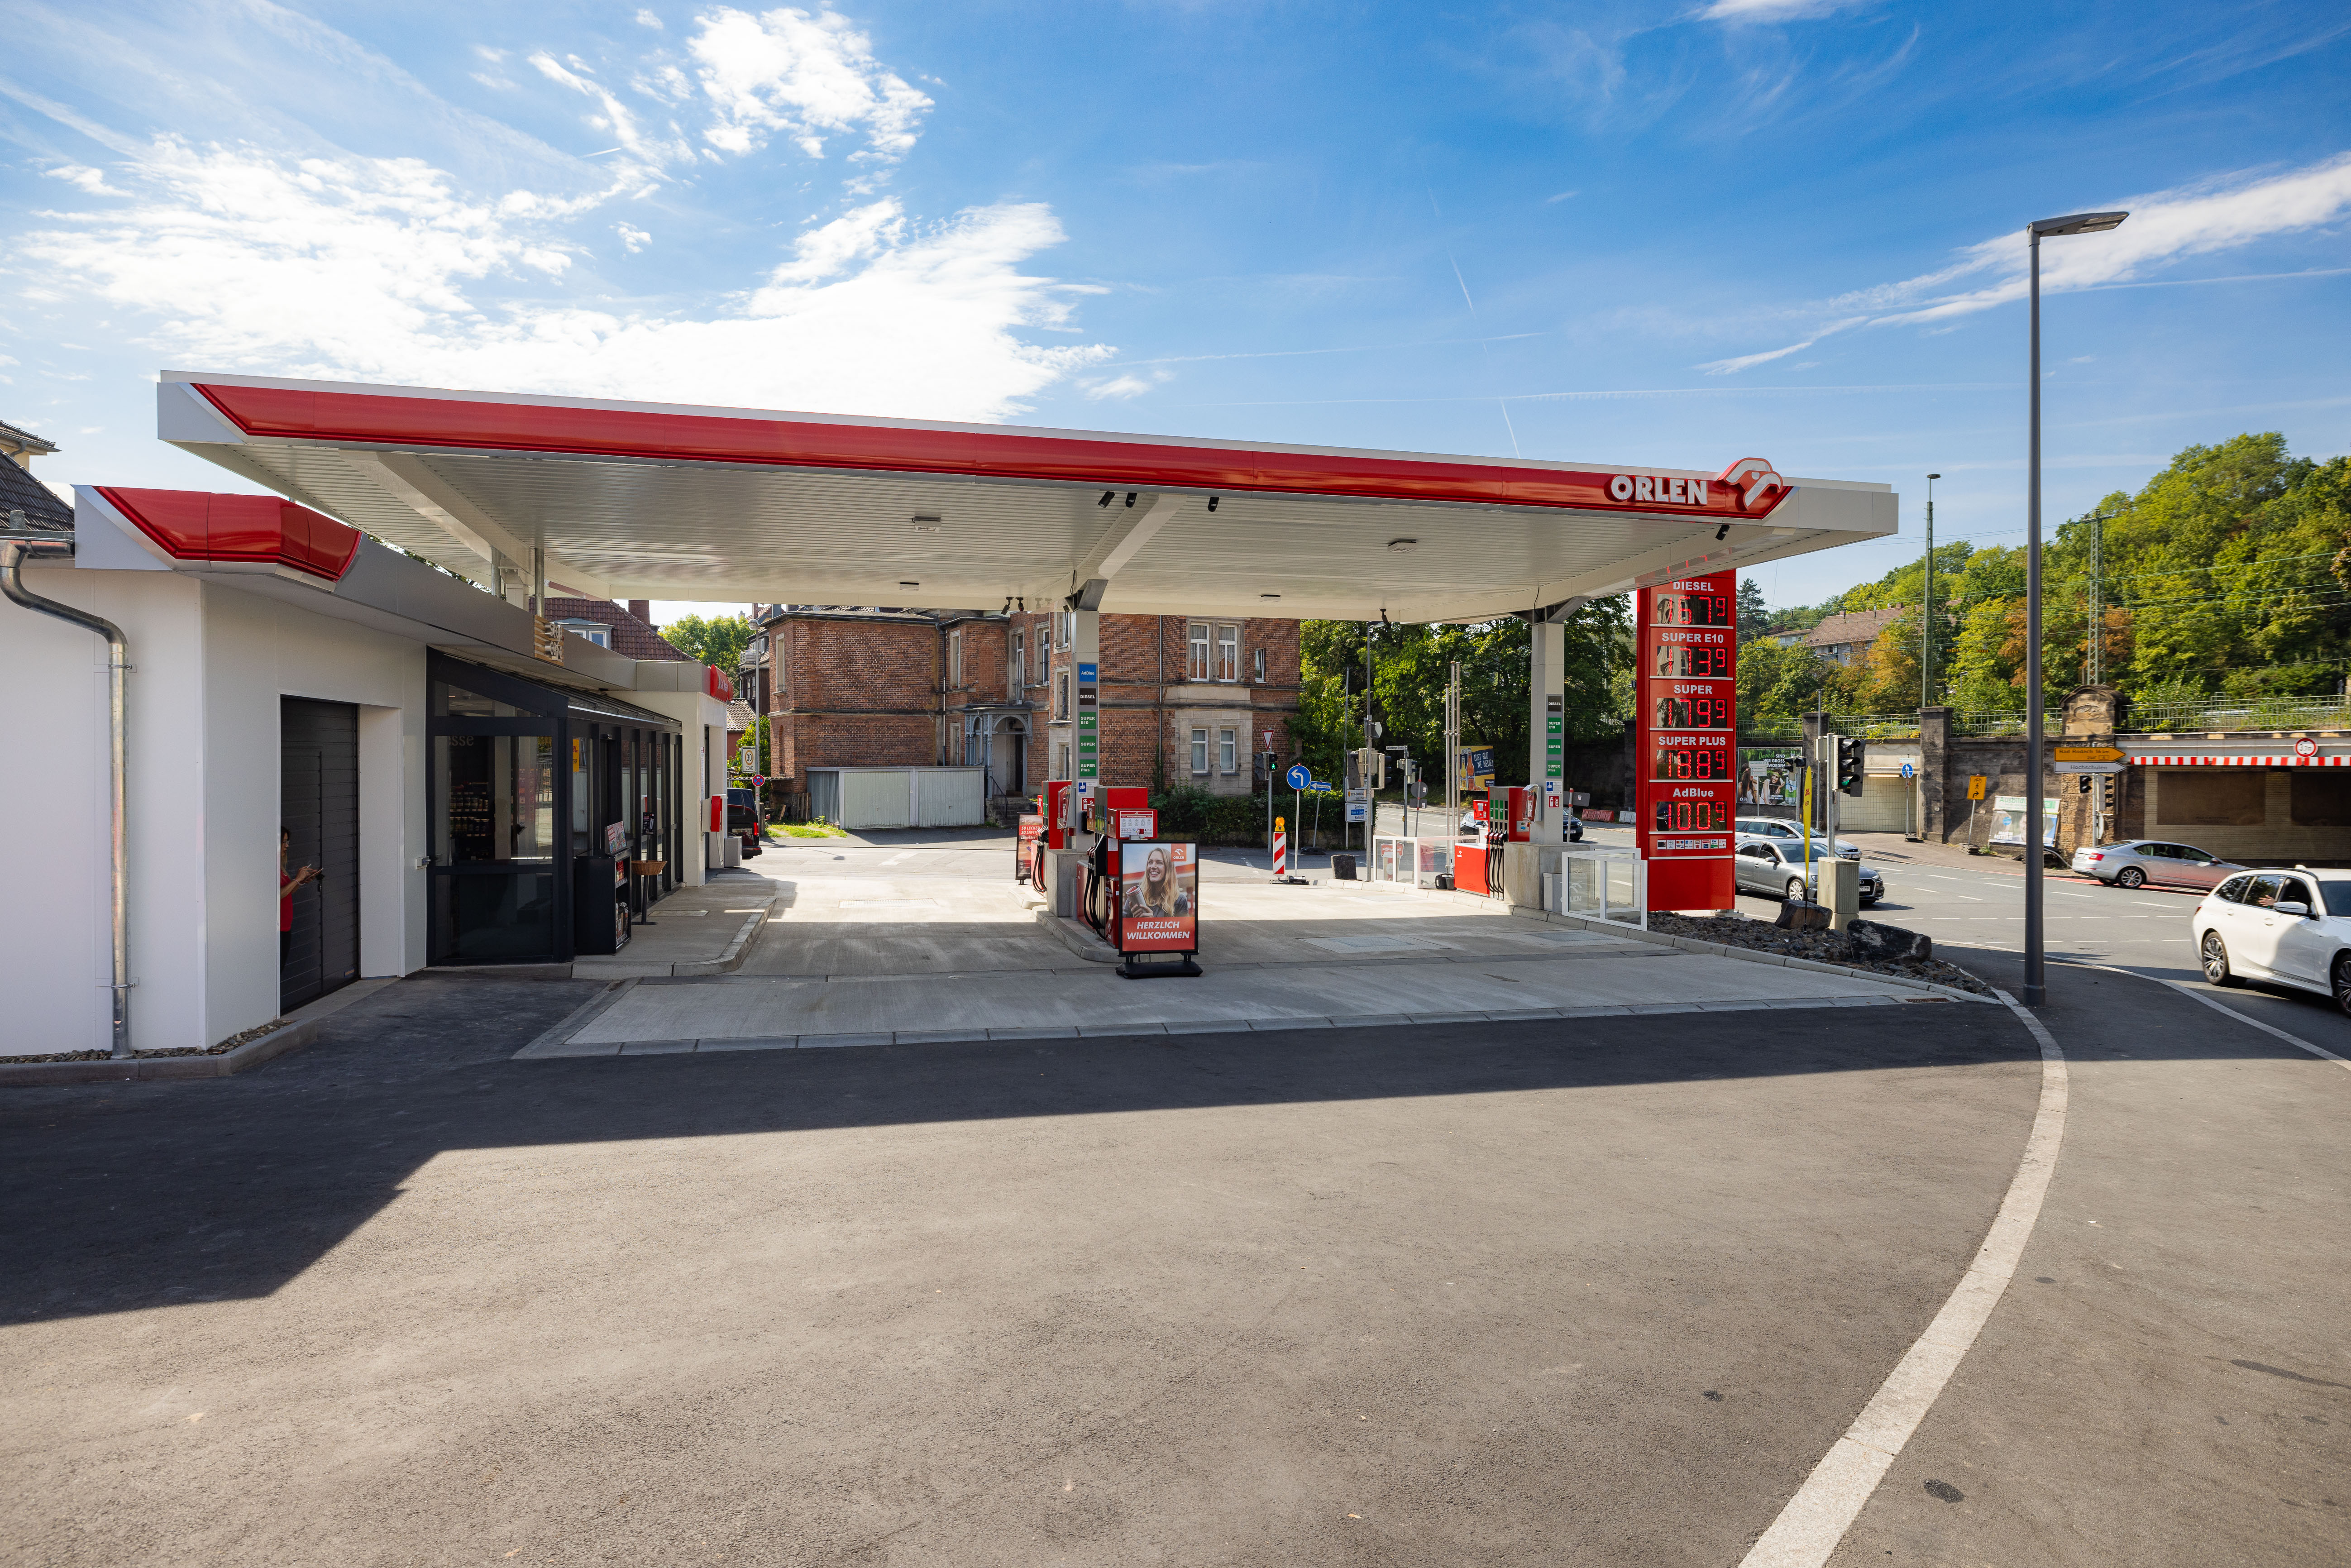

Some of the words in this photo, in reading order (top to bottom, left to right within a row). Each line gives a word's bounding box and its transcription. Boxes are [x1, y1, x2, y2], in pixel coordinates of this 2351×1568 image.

[1610, 475, 1708, 505] ORLEN
[1673, 581, 1714, 591] DIESEL
[1662, 632, 1701, 642] SUPER
[1705, 634, 1724, 643] E10
[1673, 684, 1713, 694] SUPER
[1658, 736, 1696, 746] SUPER
[1699, 736, 1726, 746] PLUS
[1759, 751, 1775, 759] Damit
[1672, 788, 1714, 797] AdBlue
[1127, 931, 1190, 939] WILLKOMMEN
